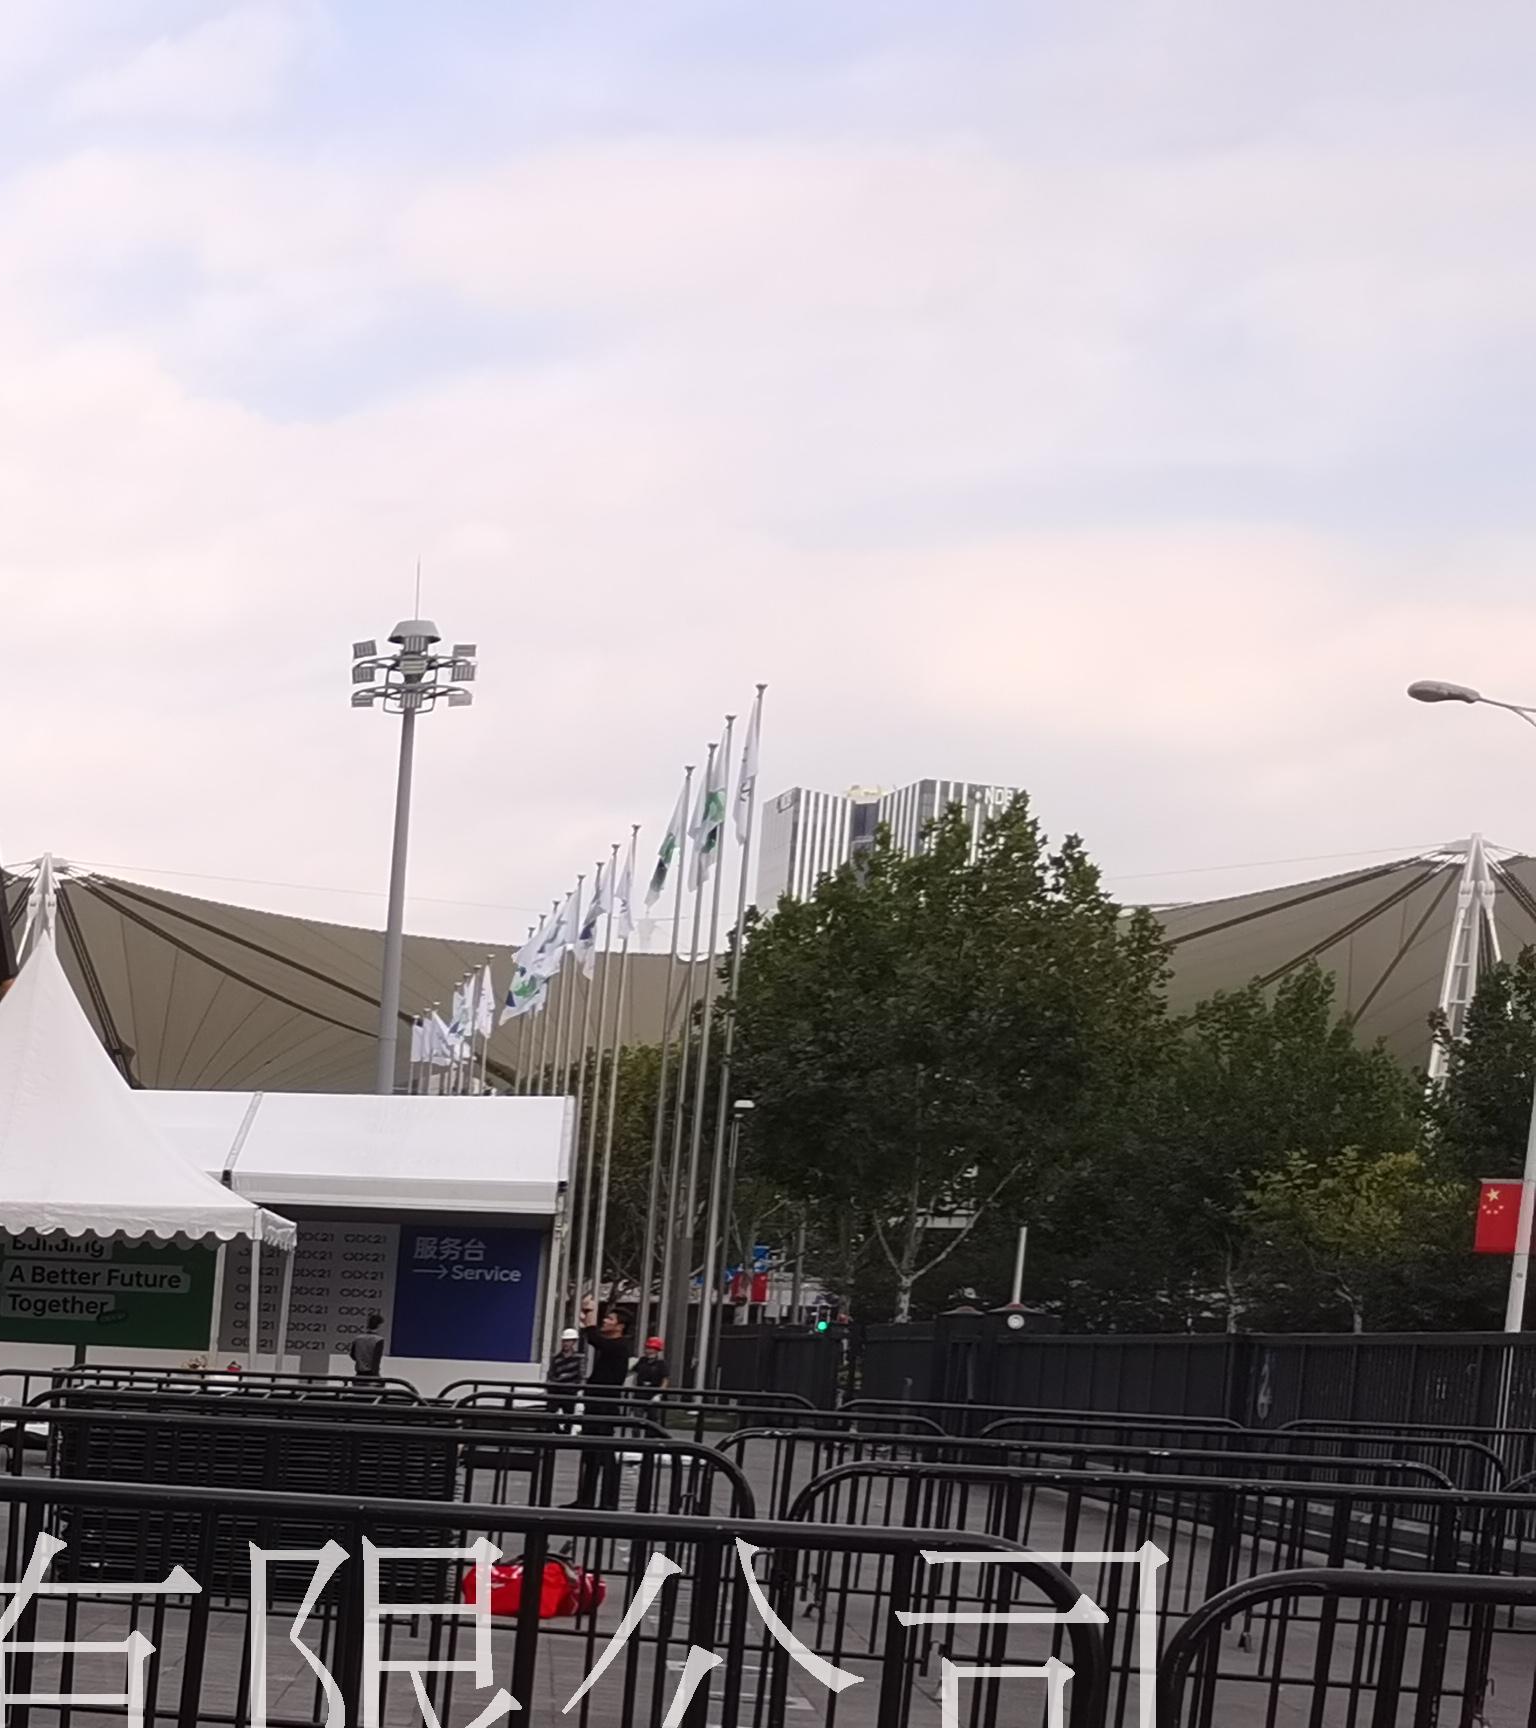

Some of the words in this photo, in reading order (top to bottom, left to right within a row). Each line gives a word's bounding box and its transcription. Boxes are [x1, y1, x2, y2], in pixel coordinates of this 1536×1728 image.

[413, 1237, 487, 1260] 服务台
[9, 1265, 25, 1283] A
[31, 1265, 101, 1286] Better
[107, 1268, 181, 1289] Future
[451, 1265, 522, 1282] Service
[8, 1293, 108, 1317] Together
